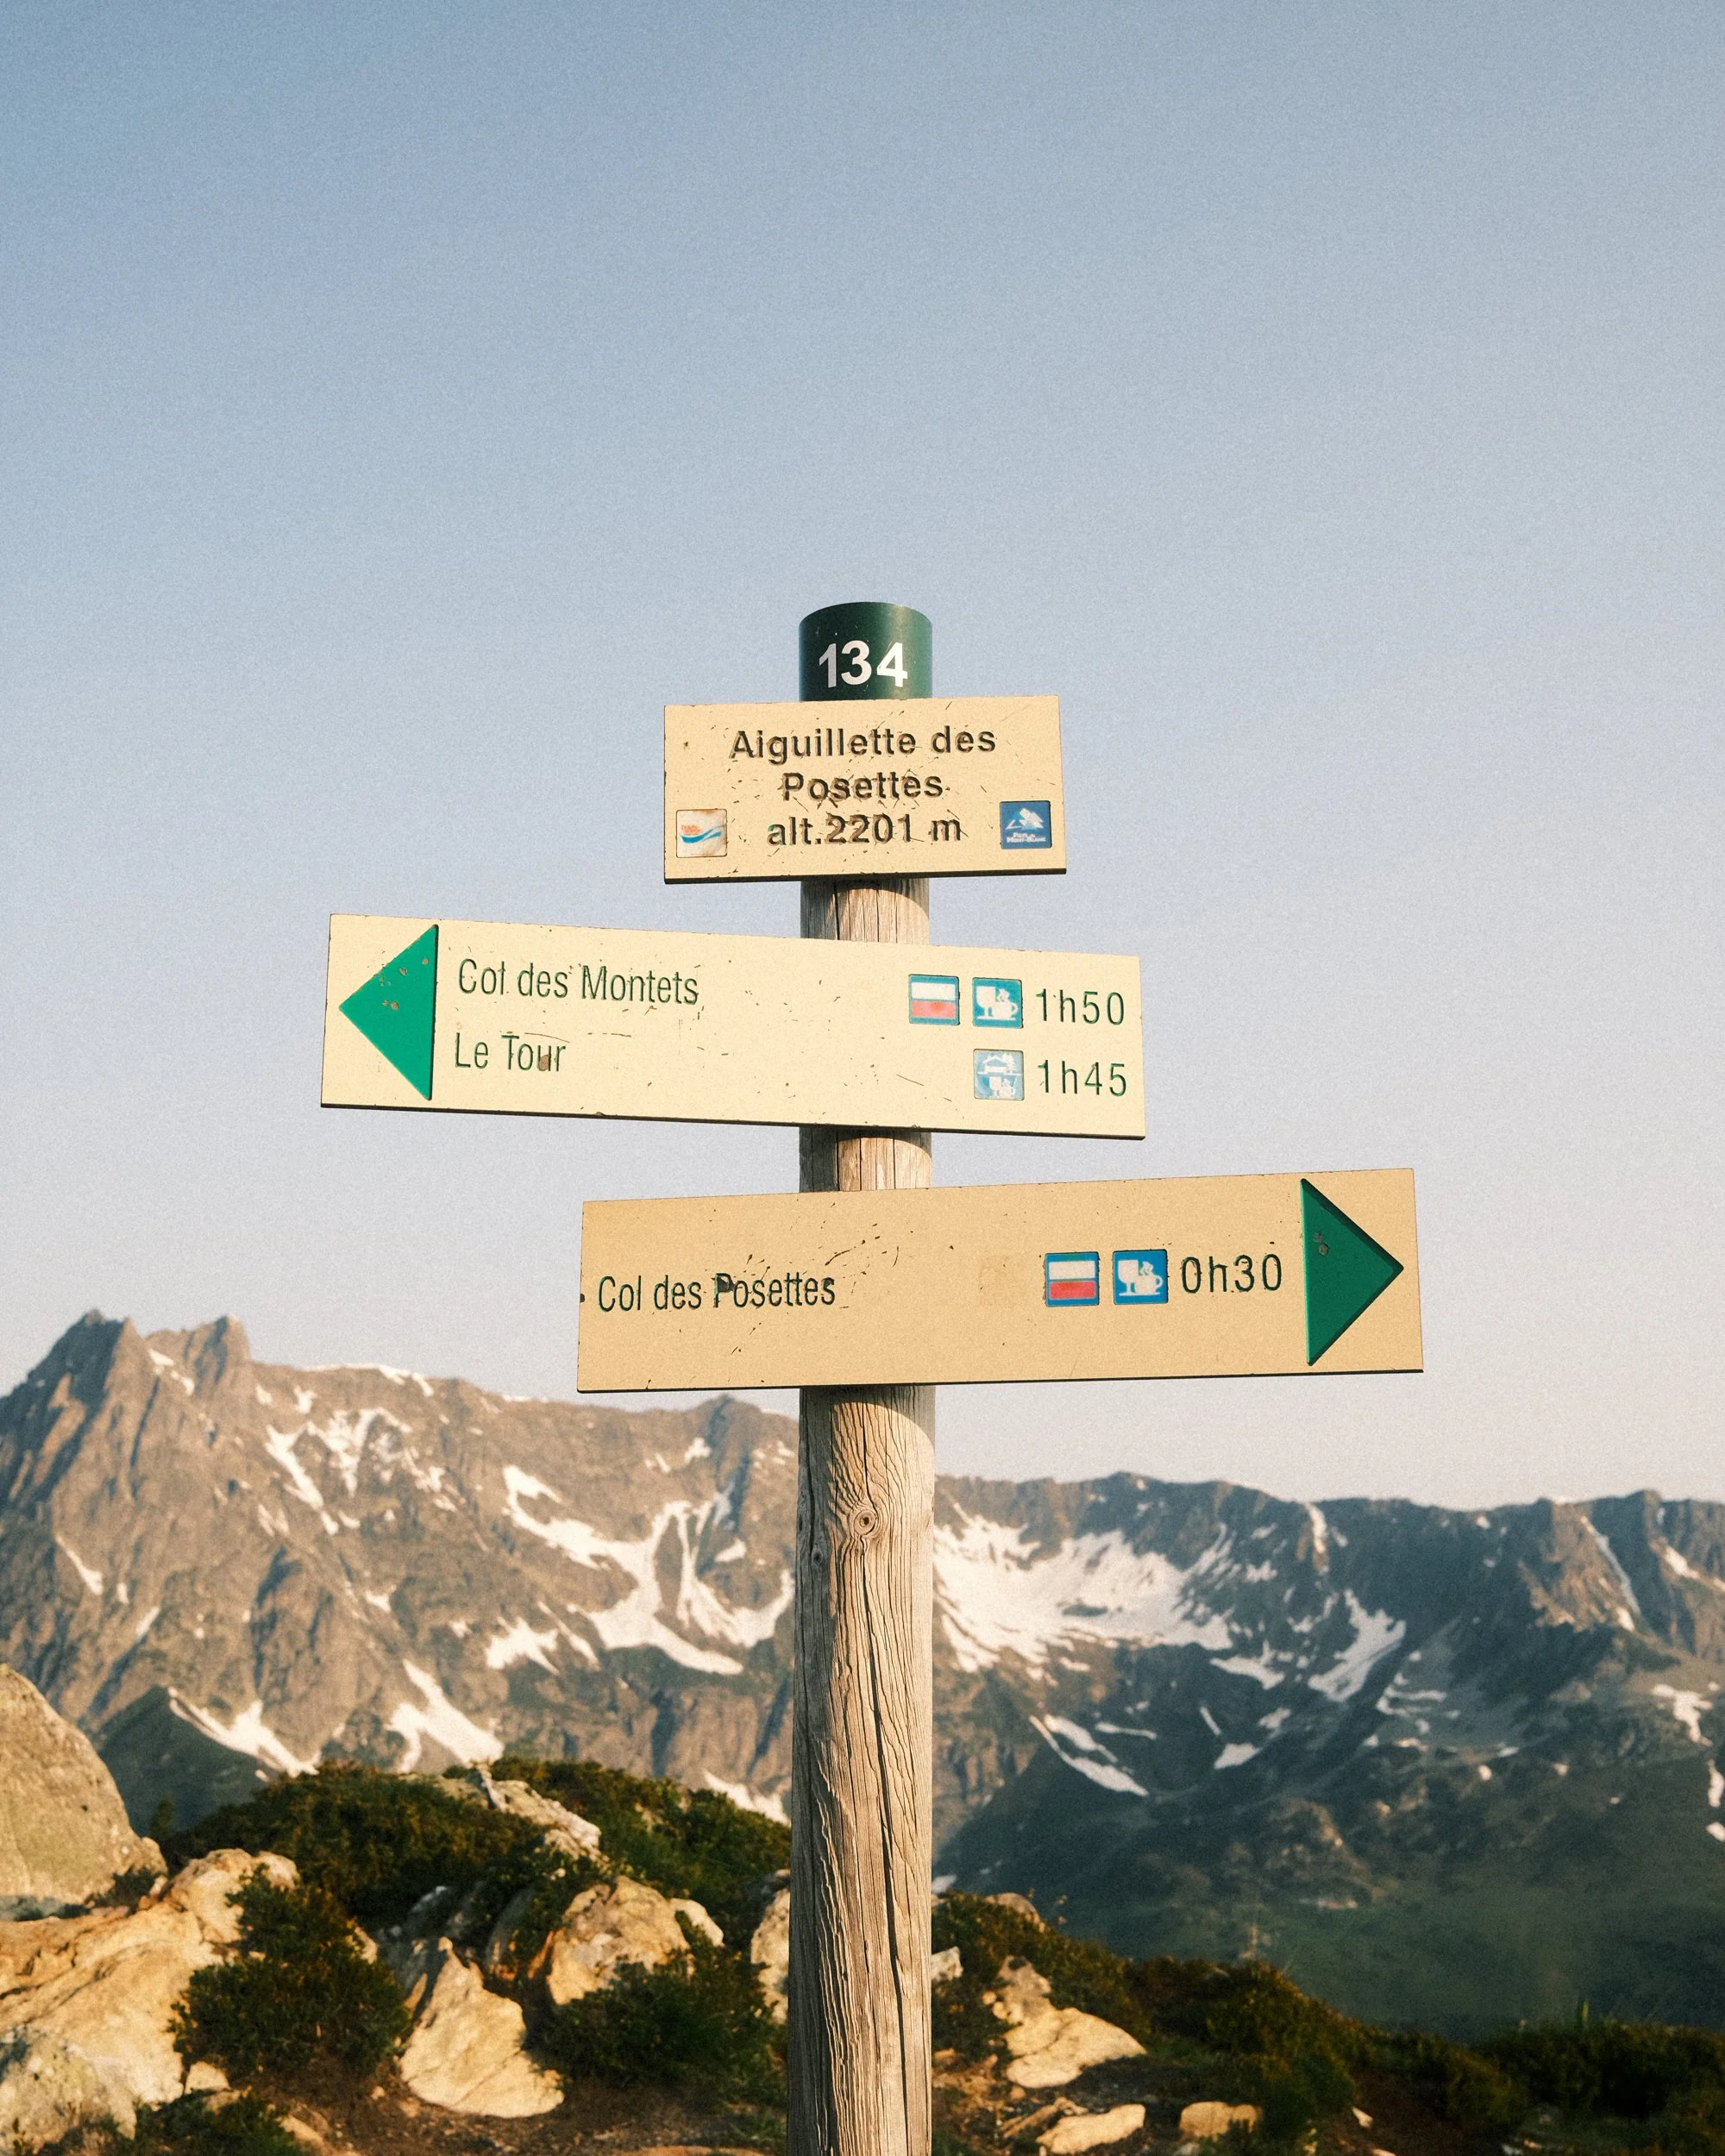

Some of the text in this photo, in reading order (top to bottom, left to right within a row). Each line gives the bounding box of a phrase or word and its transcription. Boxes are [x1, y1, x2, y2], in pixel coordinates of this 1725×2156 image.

[819, 641, 908, 688] 134
[731, 725, 996, 765] Aiguillette des
[782, 771, 944, 802] Posettes
[932, 818, 961, 841] m
[459, 958, 699, 1005] Col des Montets
[1036, 988, 1125, 1025] 1h50
[455, 1032, 566, 1071] Le Tour
[1038, 1059, 1126, 1096] 1h45
[598, 1272, 836, 1312] Col des Posettes
[1182, 1254, 1282, 1294] 0h30
